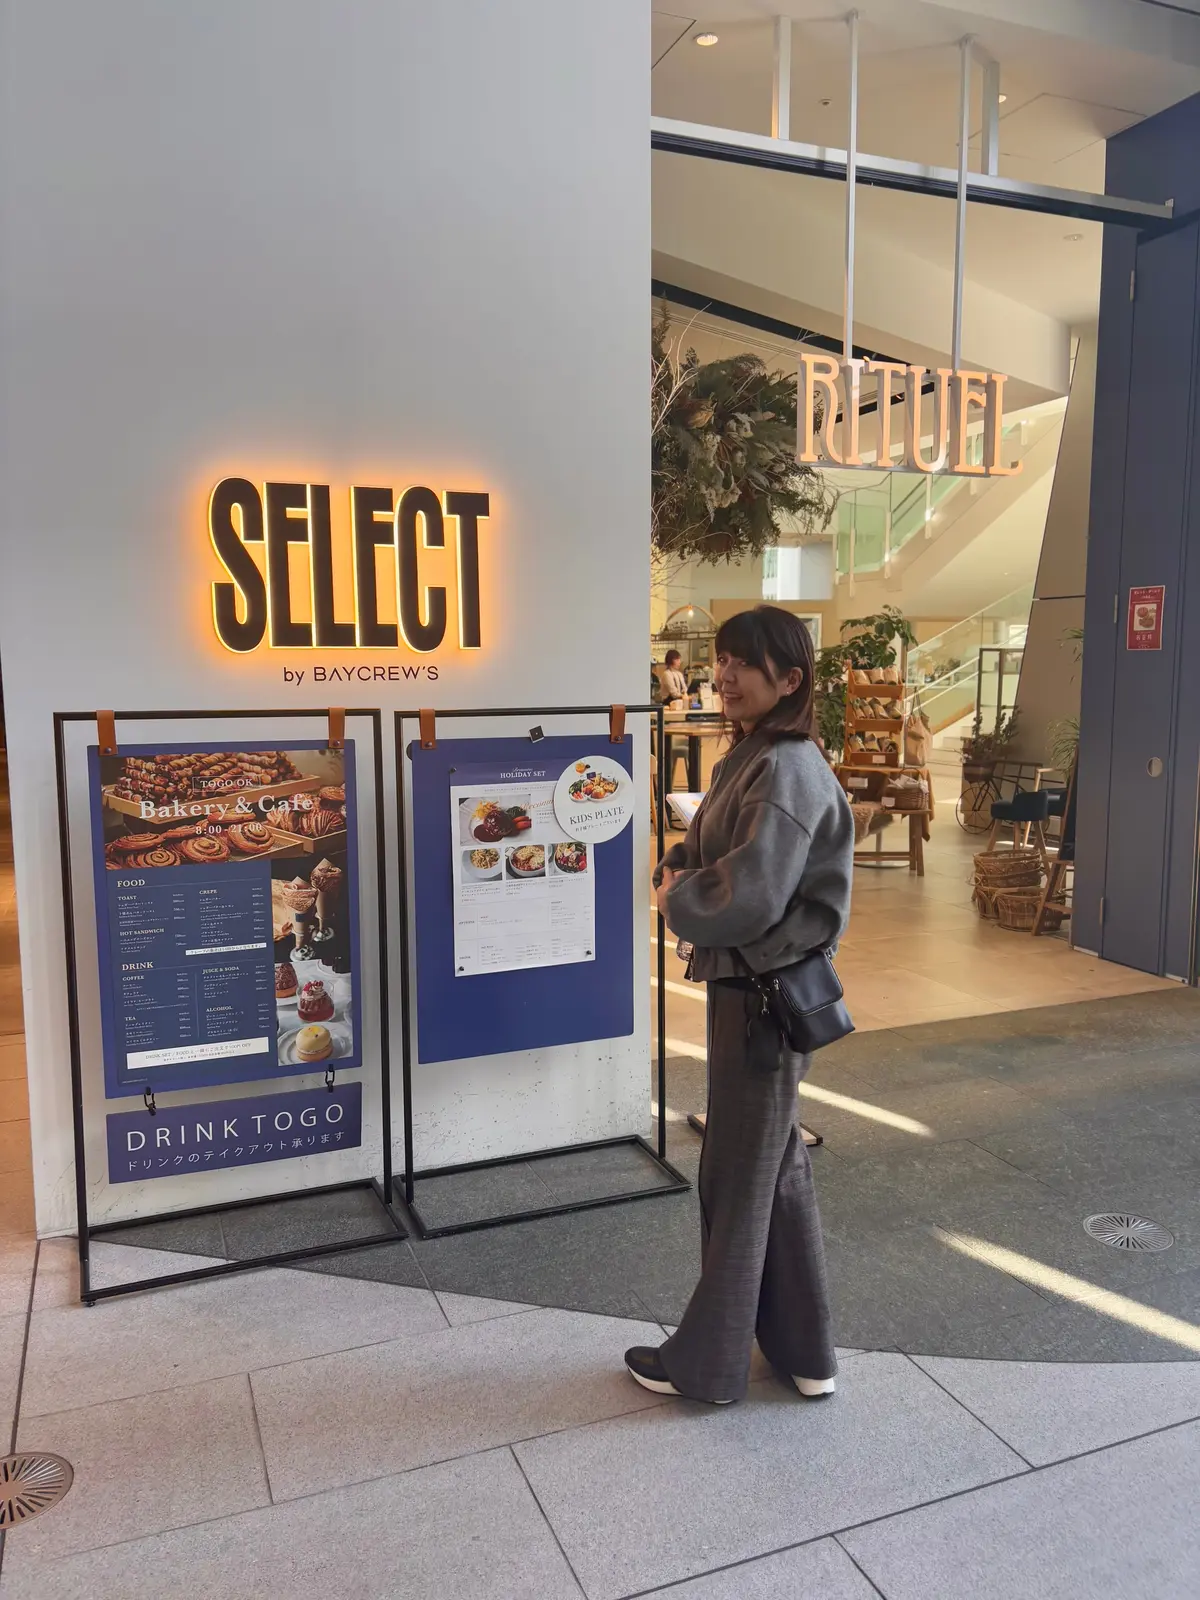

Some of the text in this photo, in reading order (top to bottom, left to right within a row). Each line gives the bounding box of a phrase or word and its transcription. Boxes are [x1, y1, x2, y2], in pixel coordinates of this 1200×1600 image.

[800, 353, 1023, 476] RITUEL
[208, 477, 490, 653] SELECT
[283, 666, 439, 686] by BAYCREW'S
[200, 778, 253, 788] TOGO OK
[500, 771, 531, 779] HOLIDAY
[139, 793, 314, 821] Bakery & Cafe
[569, 813, 593, 825] KIDS
[594, 806, 625, 821] PLATE
[117, 879, 145, 888] FOOD
[122, 961, 154, 971] DRINK
[206, 1005, 233, 1013] ALCOHOL
[127, 1103, 344, 1151] DRINK TOGO
[128, 1131, 345, 1172] ドリンクのテイクアウト承ります
